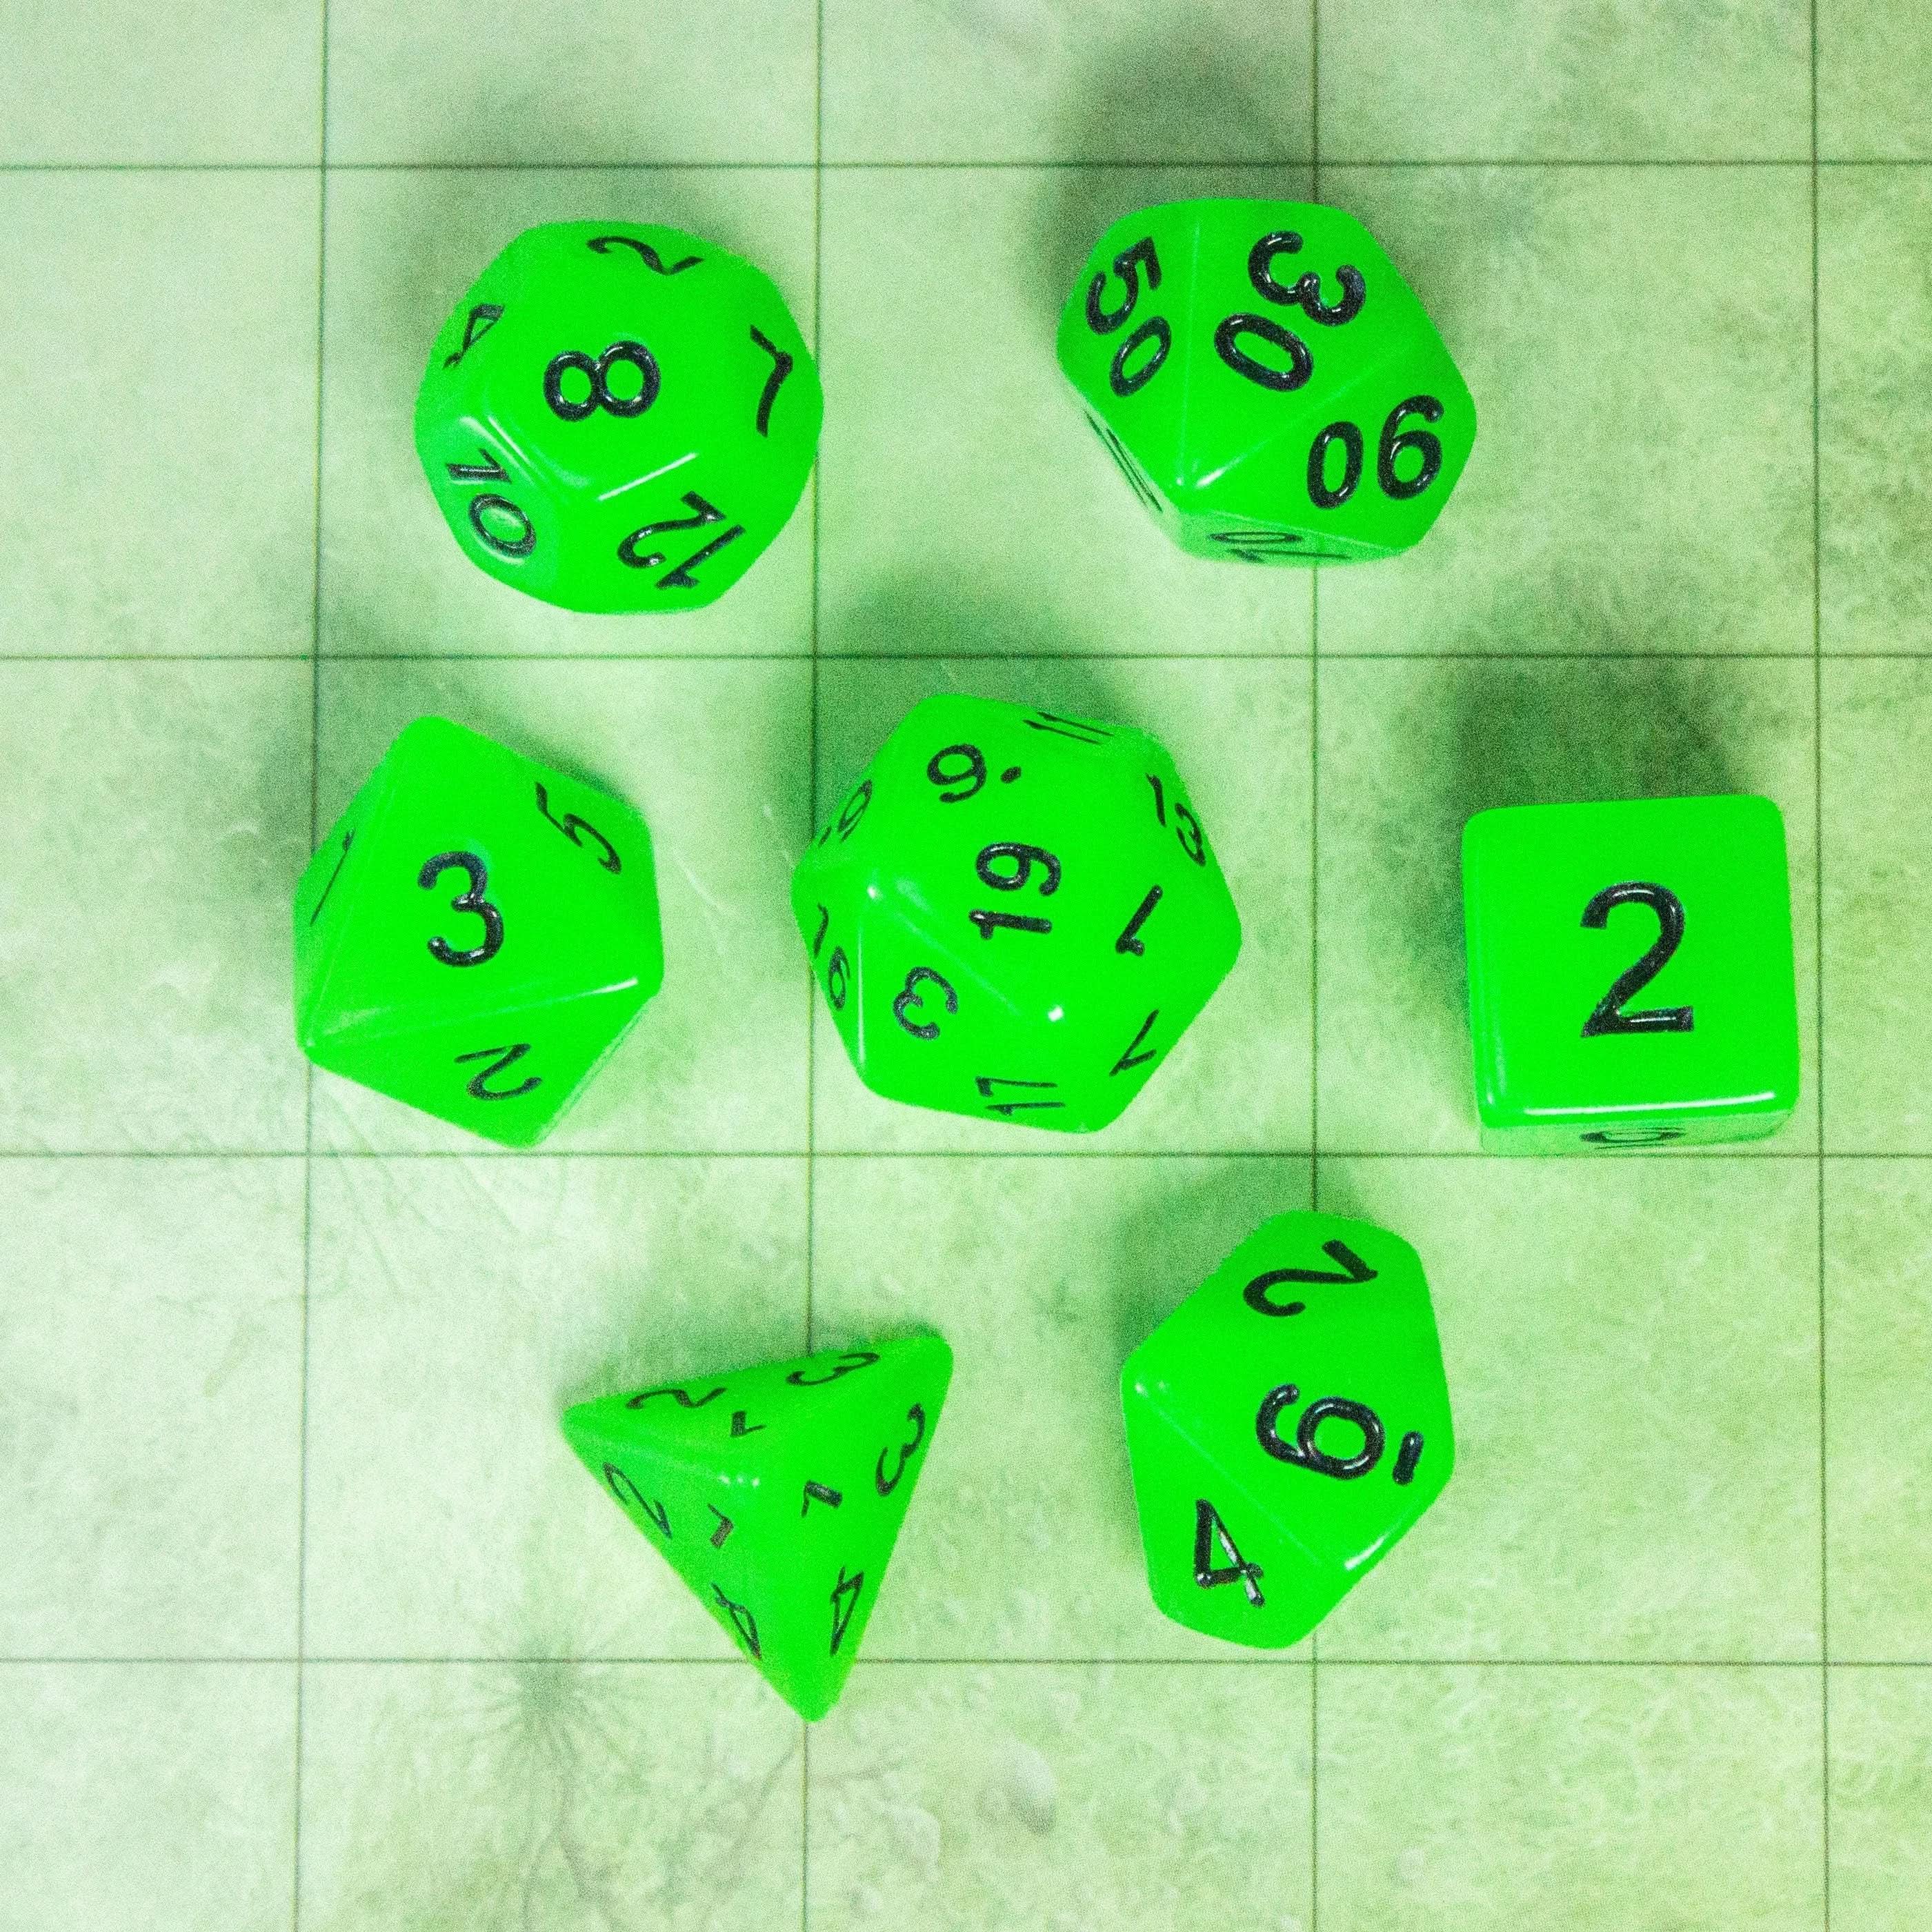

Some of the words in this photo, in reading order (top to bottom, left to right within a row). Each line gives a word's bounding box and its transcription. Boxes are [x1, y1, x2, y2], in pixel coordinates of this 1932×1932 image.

[586, 236, 704, 275] 2
[444, 303, 504, 368] 4
[1085, 237, 1171, 397] 50
[1214, 231, 1366, 392] 30
[544, 341, 661, 421] 8
[446, 449, 537, 557] 10
[617, 491, 745, 589] 12
[535, 781, 621, 874] 5
[418, 851, 504, 967] 3
[968, 842, 1061, 939] 19
[1115, 885, 1163, 956] 1
[1581, 882, 1694, 1037] 2
[893, 967, 957, 1040] 3
[455, 1044, 542, 1100] 2
[975, 1077, 1065, 1115] 17
[1243, 1239, 1377, 1317] 2
[626, 1387, 726, 1409] 2
[786, 1352, 880, 1386] 3
[875, 1403, 925, 1496] 3
[602, 1462, 672, 1539] 2
[1194, 1499, 1265, 1607] 4
[712, 1583, 761, 1660] 4
[830, 1567, 864, 1655] 4
